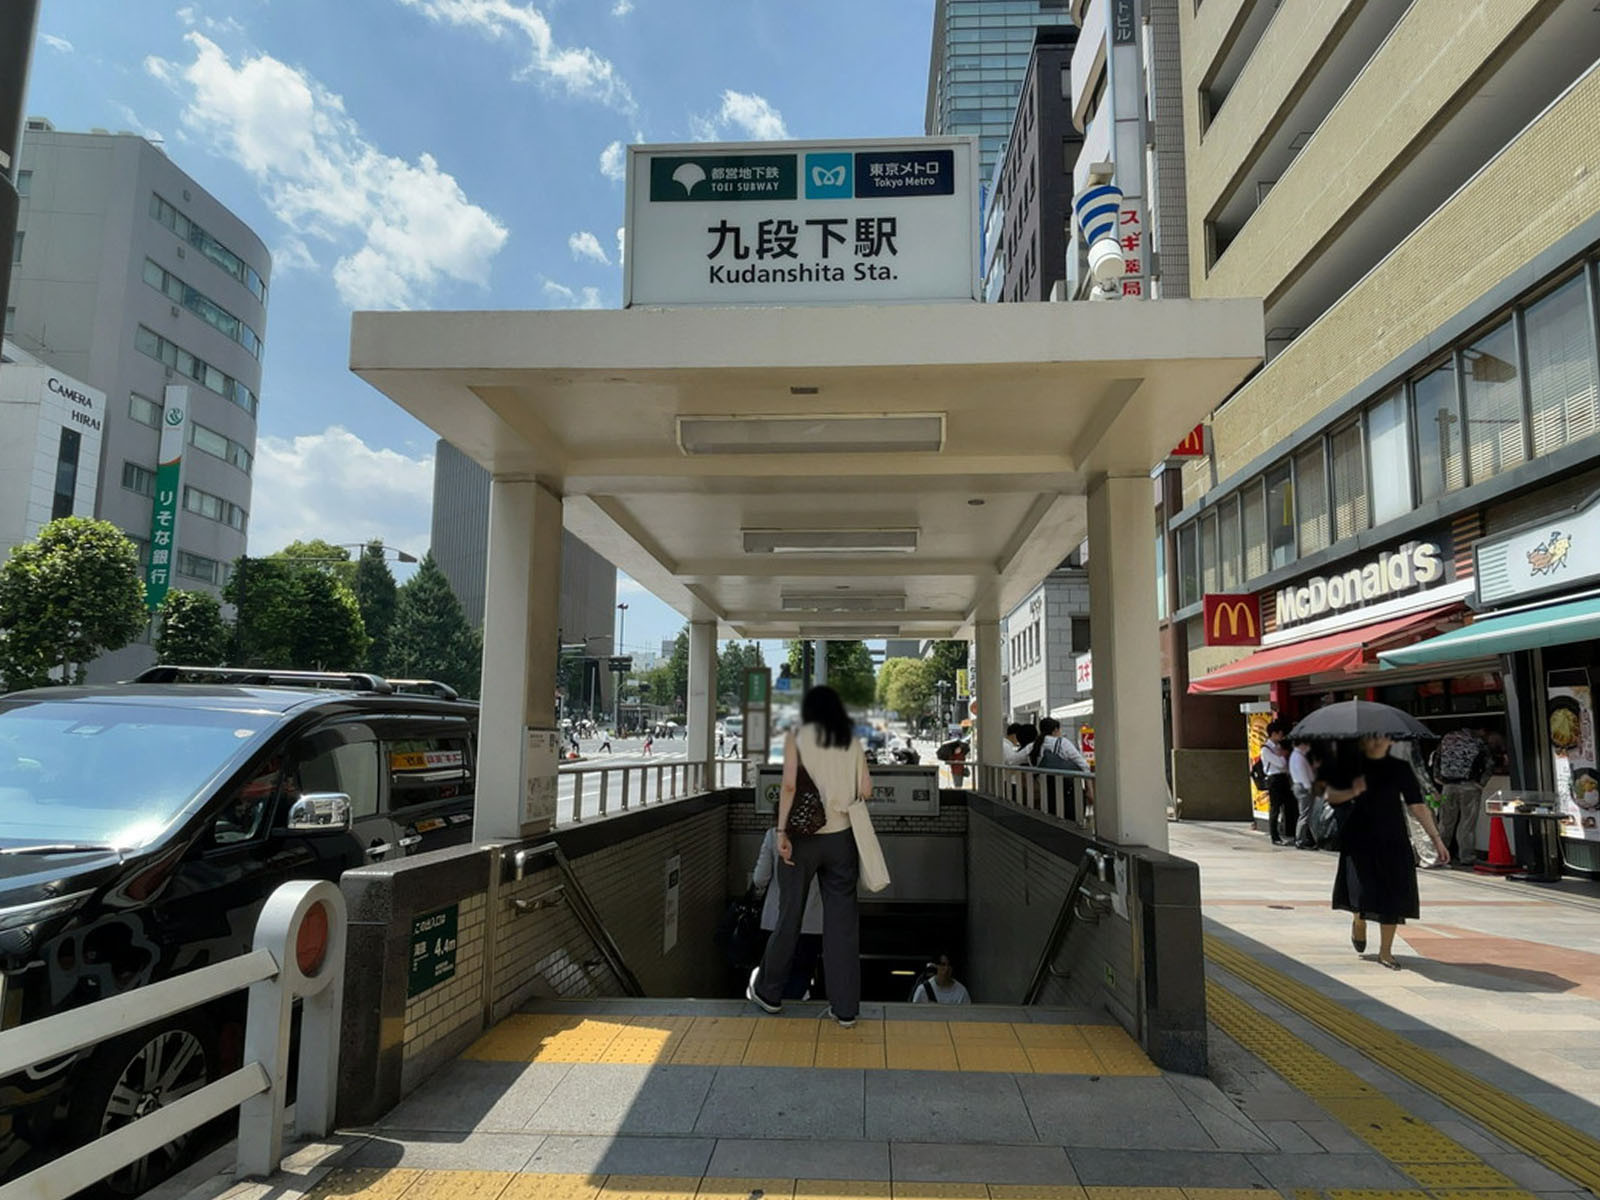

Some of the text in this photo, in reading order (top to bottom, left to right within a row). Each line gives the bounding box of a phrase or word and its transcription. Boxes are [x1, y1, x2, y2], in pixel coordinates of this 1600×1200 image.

[711, 166, 780, 180] 都営地下鉄
[869, 162, 940, 177] 東京メトロ
[711, 182, 780, 192] TOEI SUBWAY
[874, 175, 936, 189] Tokyo Metro
[707, 217, 898, 260] 九段下駅
[1119, 210, 1142, 297] スギ薬局
[709, 262, 898, 284] Kudanshita Sta.
[48, 377, 93, 409] CAMERA
[72, 410, 101, 431] HIRAI
[151, 490, 174, 585] りそな銀行
[1276, 540, 1443, 628] McDonald's
